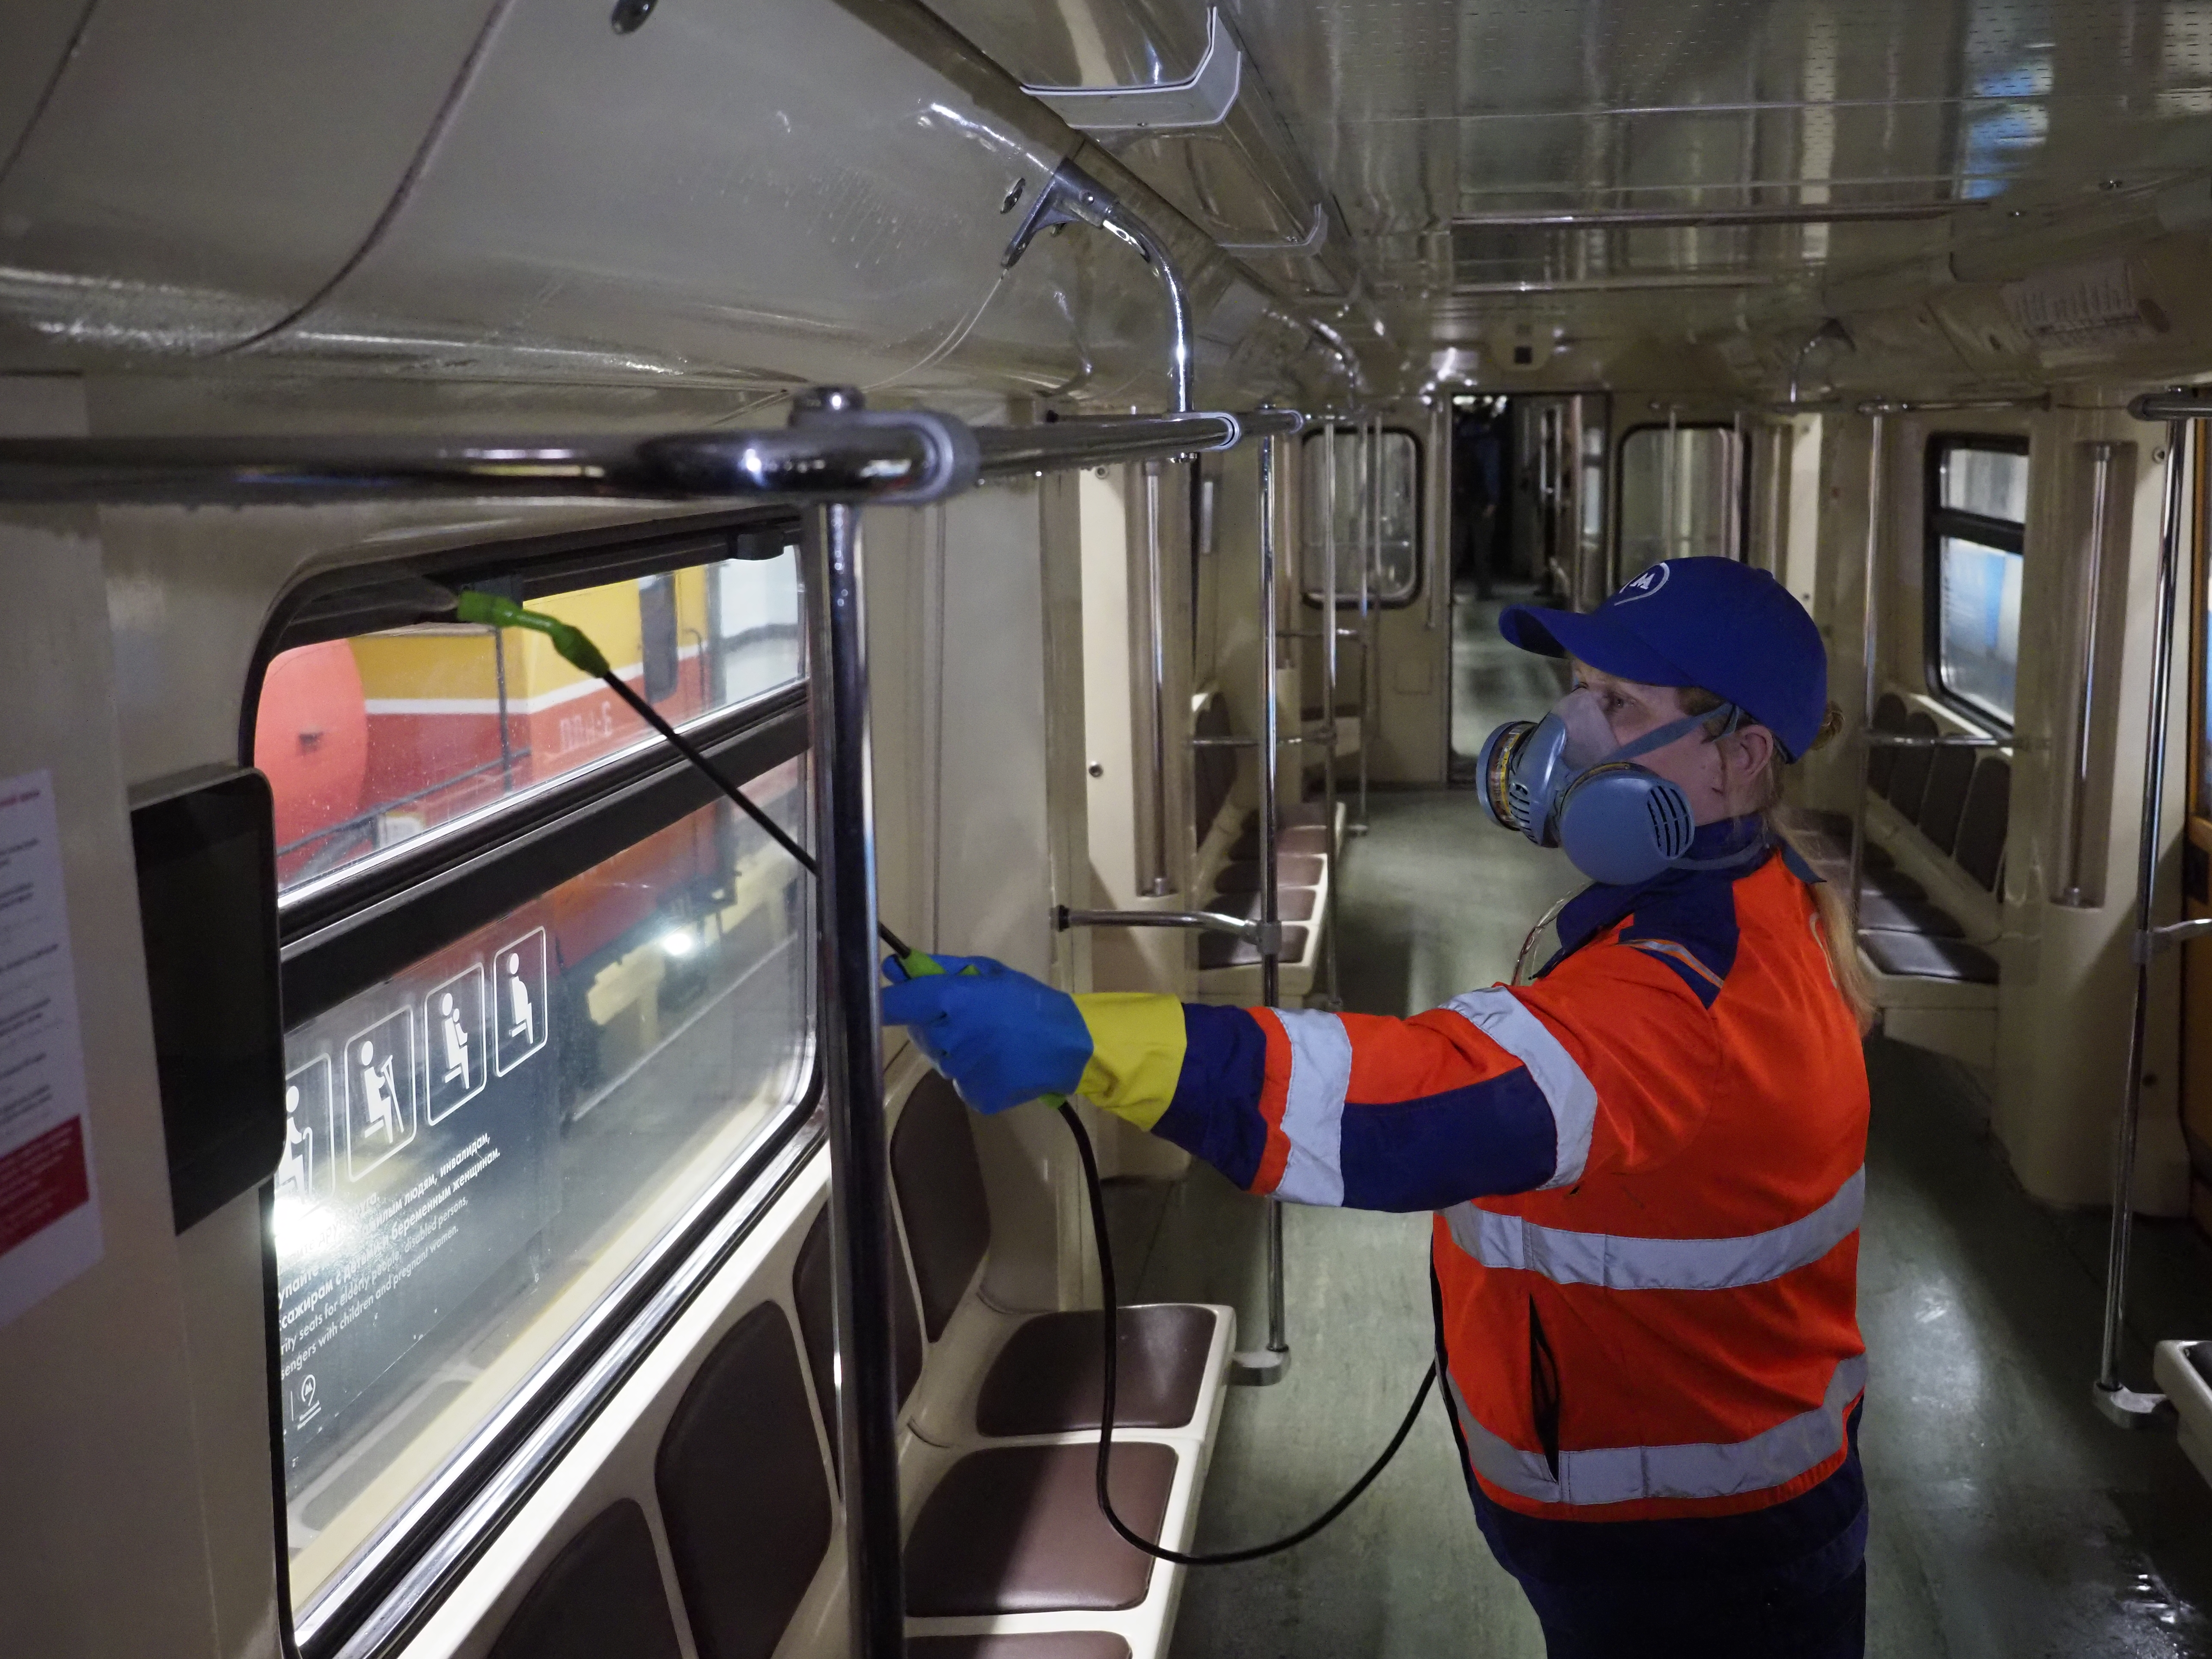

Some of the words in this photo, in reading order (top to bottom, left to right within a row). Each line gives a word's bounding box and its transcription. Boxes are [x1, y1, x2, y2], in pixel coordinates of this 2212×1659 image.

[392, 1185, 451, 1240] беременным
[453, 1148, 501, 1193] женщинам.
[405, 1174, 437, 1207] людям,
[440, 1132, 490, 1178] инвалидам,
[300, 1314, 323, 1340] seats
[325, 1302, 338, 1319] for
[340, 1270, 370, 1306] elderly
[372, 1250, 402, 1285] people,
[405, 1215, 437, 1253] disabled
[439, 1196, 468, 1229] persons,
[318, 1321, 338, 1347] with
[340, 1295, 374, 1330] children
[375, 1274, 391, 1299] and
[394, 1247, 428, 1289] pregnant
[430, 1225, 459, 1253] women.
